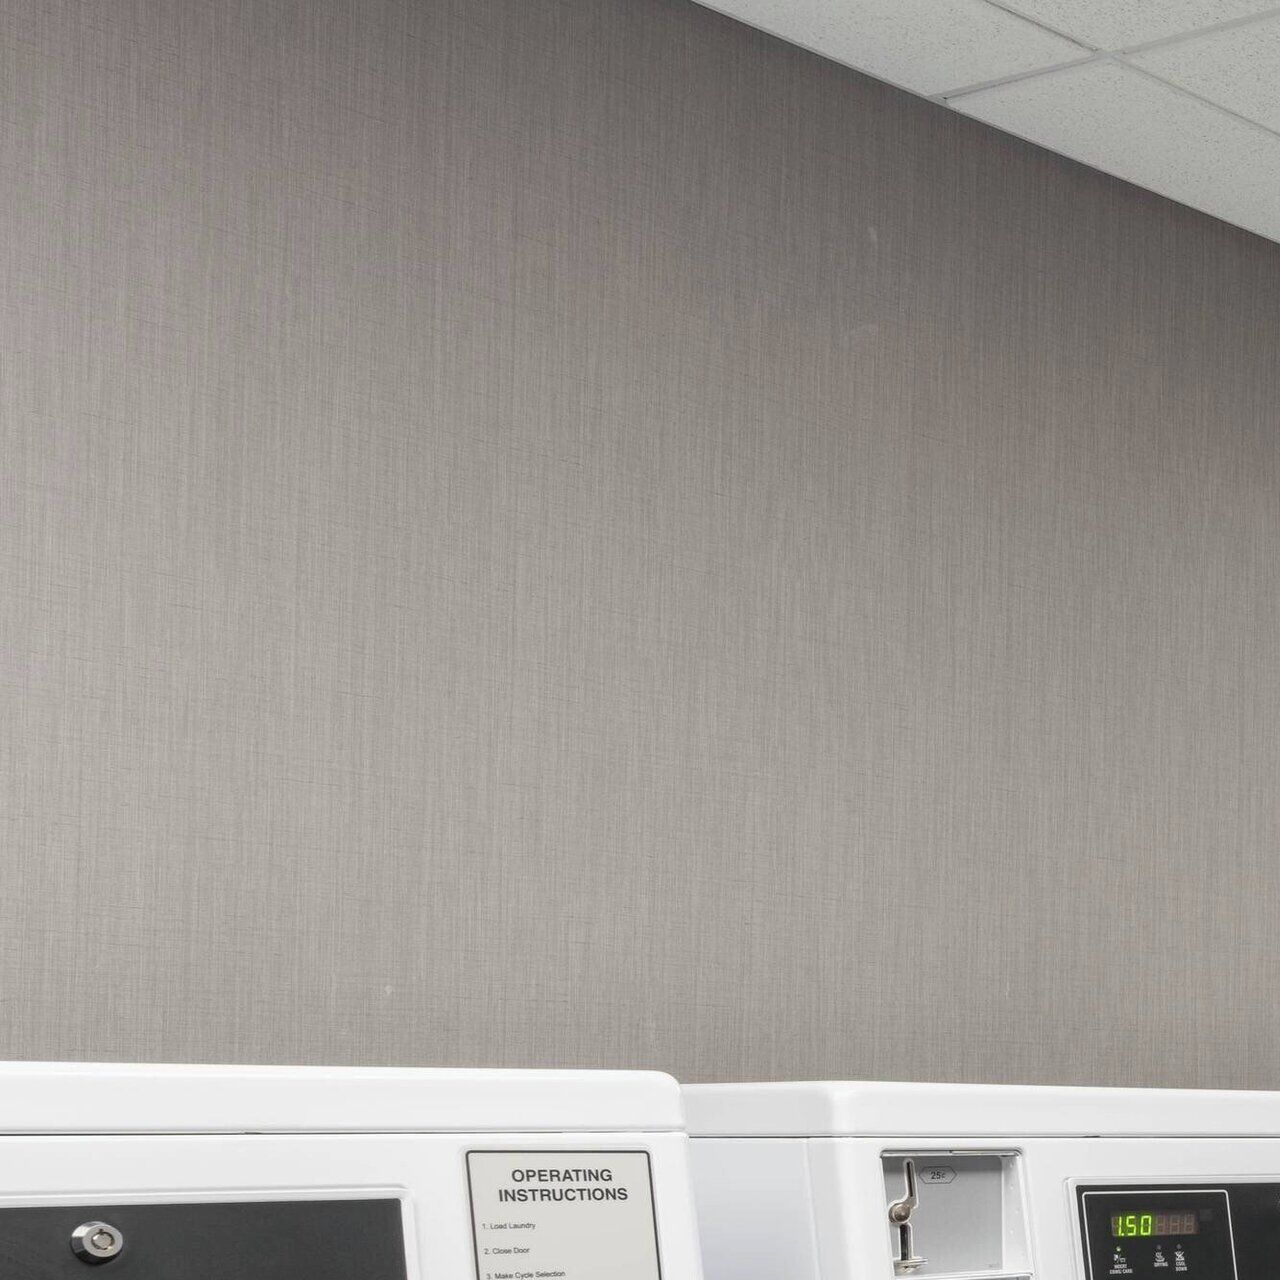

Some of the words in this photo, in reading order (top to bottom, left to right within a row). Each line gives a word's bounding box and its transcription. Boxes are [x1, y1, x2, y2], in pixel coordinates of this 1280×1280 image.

[511, 1168, 613, 1182] OPERATING
[498, 1188, 628, 1202] INSTRUCTIONS
[490, 1222, 508, 1230] Load
[508, 1222, 536, 1230] Laundry
[1118, 1215, 1152, 1236] 1.50
[515, 1272, 534, 1280] Cycle
[536, 1270, 566, 1278] Selection
